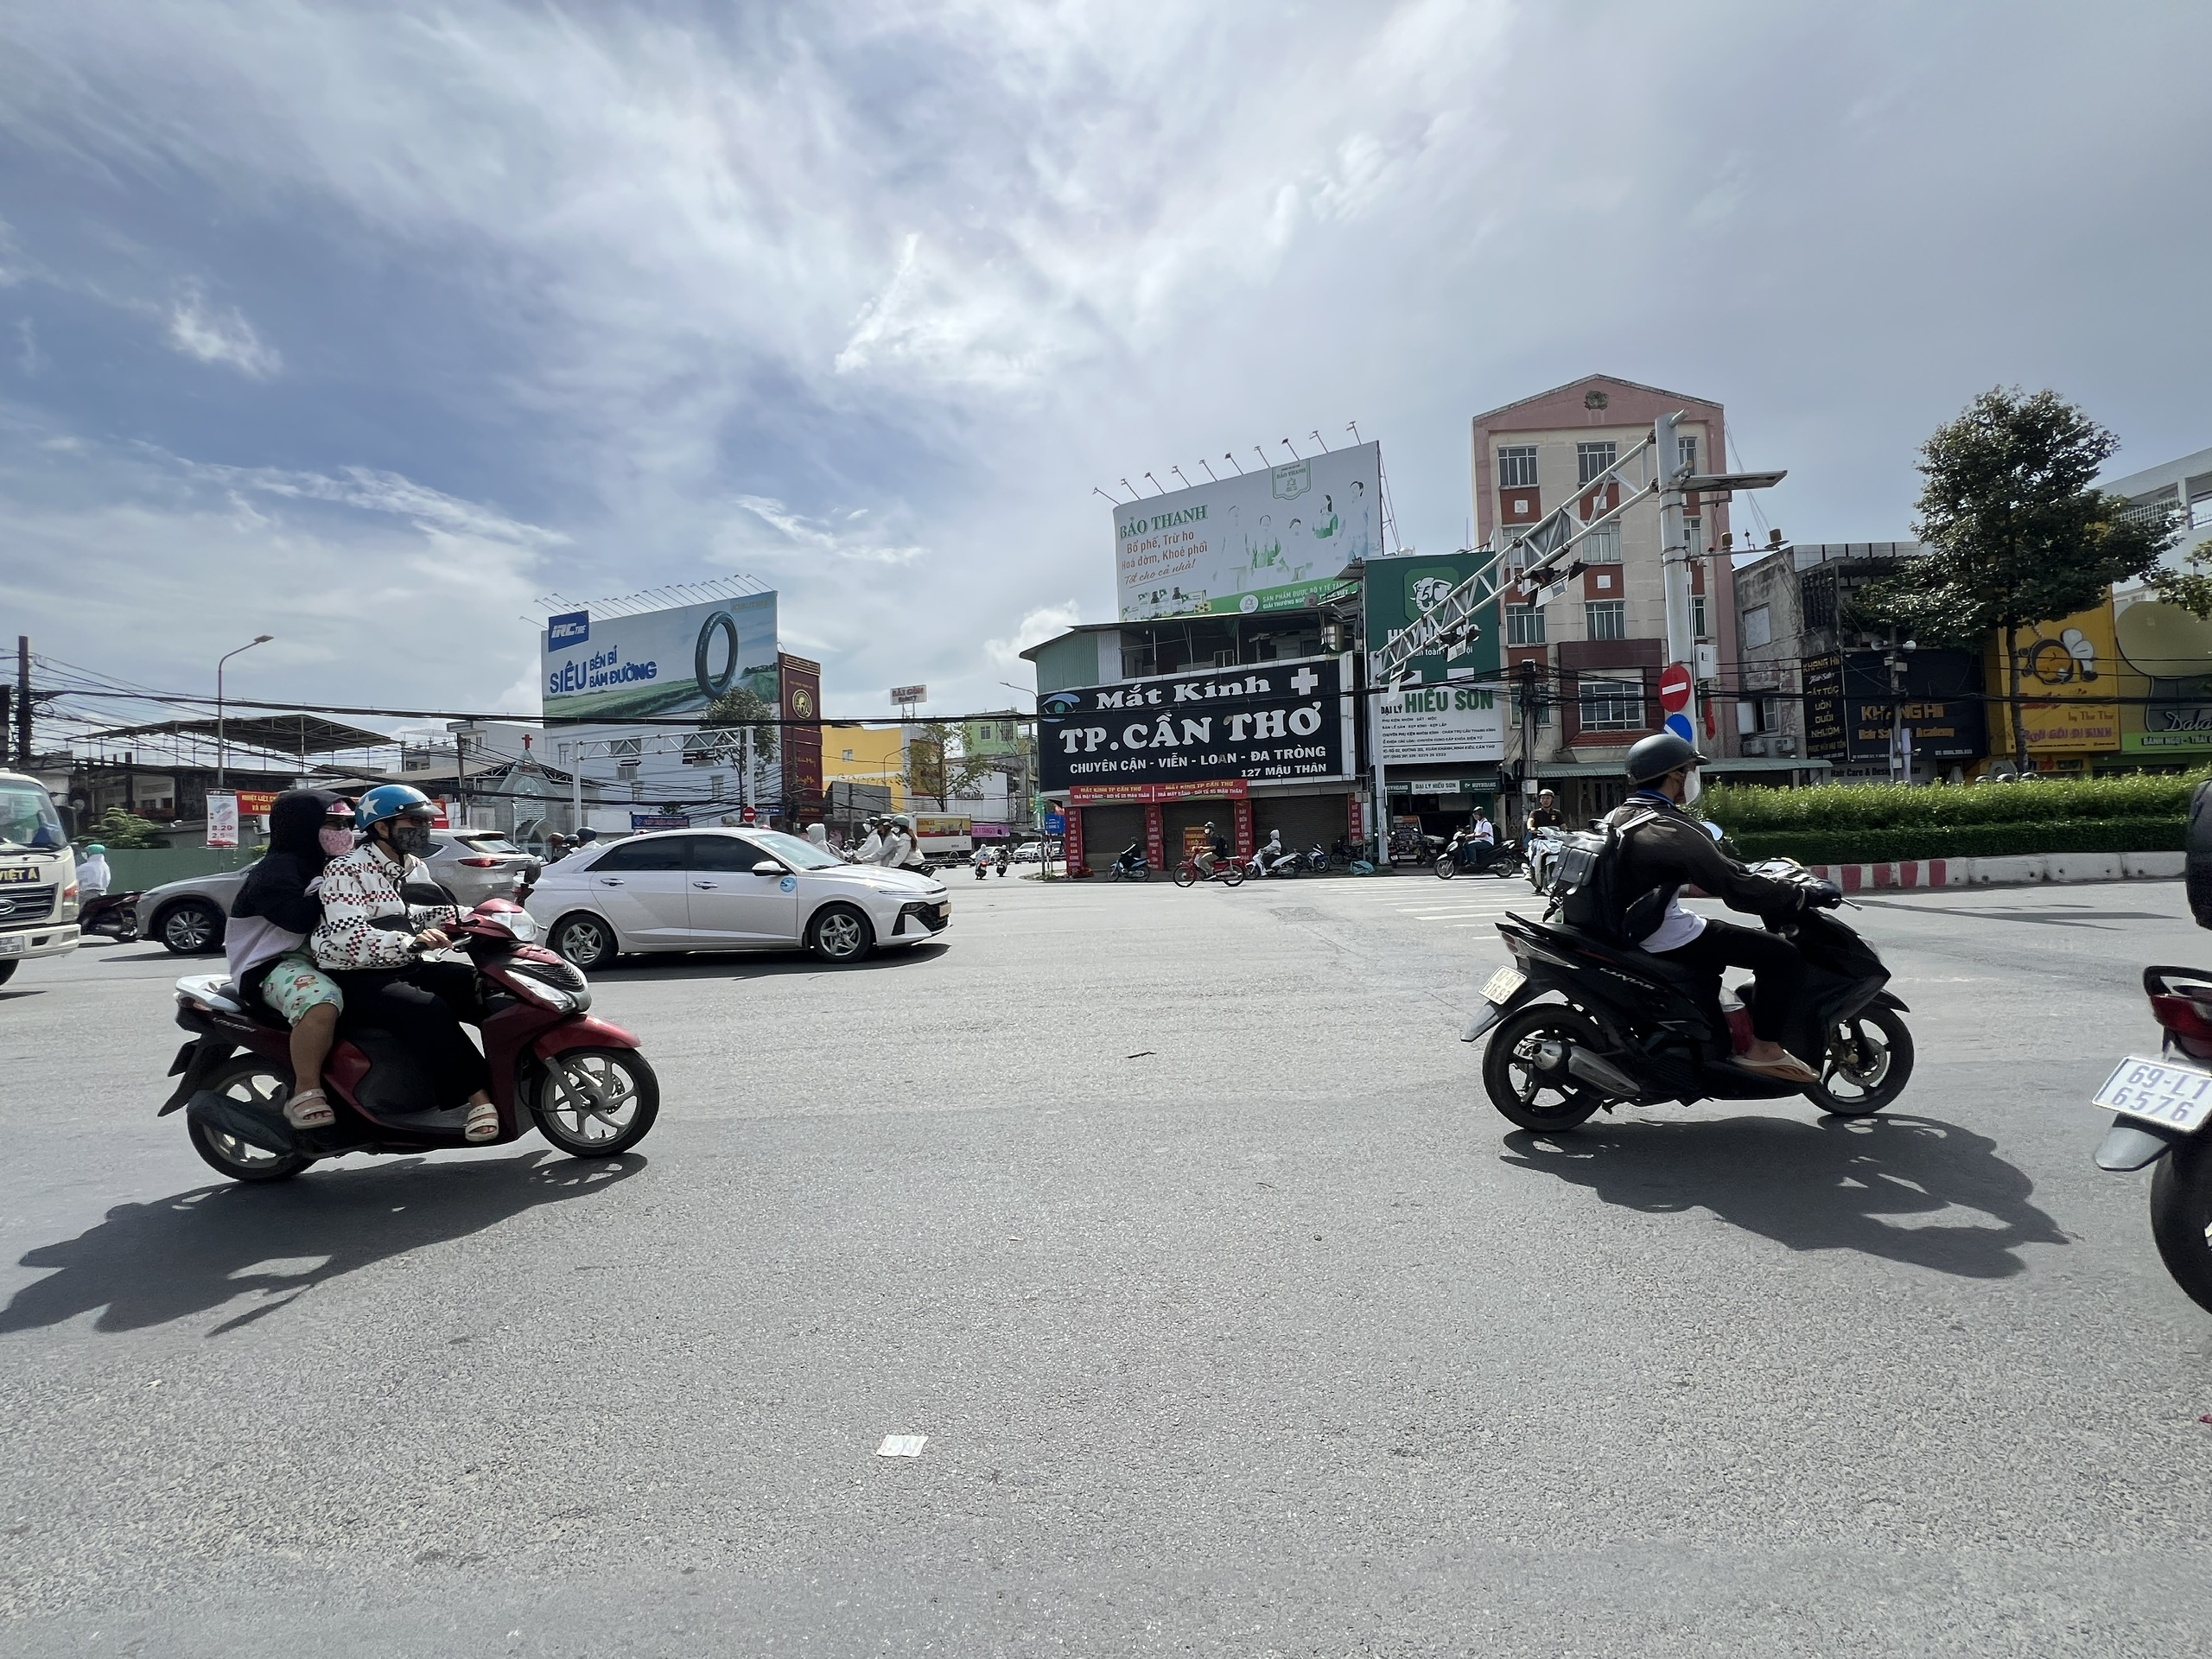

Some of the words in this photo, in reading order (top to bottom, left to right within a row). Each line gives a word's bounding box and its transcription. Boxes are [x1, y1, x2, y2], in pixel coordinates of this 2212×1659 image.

[1120, 517, 1147, 539] BẢO
[1151, 505, 1208, 531] THANH
[1127, 540, 1139, 554] Bổ
[1141, 536, 1160, 553] phế,
[1162, 533, 1179, 545] Trừ
[1182, 531, 1194, 541] ho
[1138, 555, 1160, 566] đờm,
[1187, 541, 1208, 557] phổi
[1124, 572, 1138, 585] Tốt
[1139, 571, 1155, 582] cho
[550, 660, 587, 693] SIÊU
[589, 671, 608, 688] BÁM
[609, 661, 657, 684] ĐƯỜNG
[1096, 683, 1162, 709] Mắt
[1173, 676, 1271, 702] Kính
[1223, 701, 1322, 741] THƠ
[1070, 759, 1117, 773] CHUYÊN
[1120, 757, 1147, 772] CẬN
[1158, 753, 1188, 768] VIỄN
[1250, 750, 1270, 761] ĐA
[1274, 744, 1326, 760] TRÒNG
[1241, 768, 1261, 777] 127
[1265, 765, 1291, 777] MẬU
[1294, 762, 1326, 774] THÂN
[1847, 768, 1863, 777] Care
[1872, 766, 1891, 777] Desig
[2126, 1065, 2212, 1100] 69-L1
[2111, 1087, 2195, 1122] 6576
